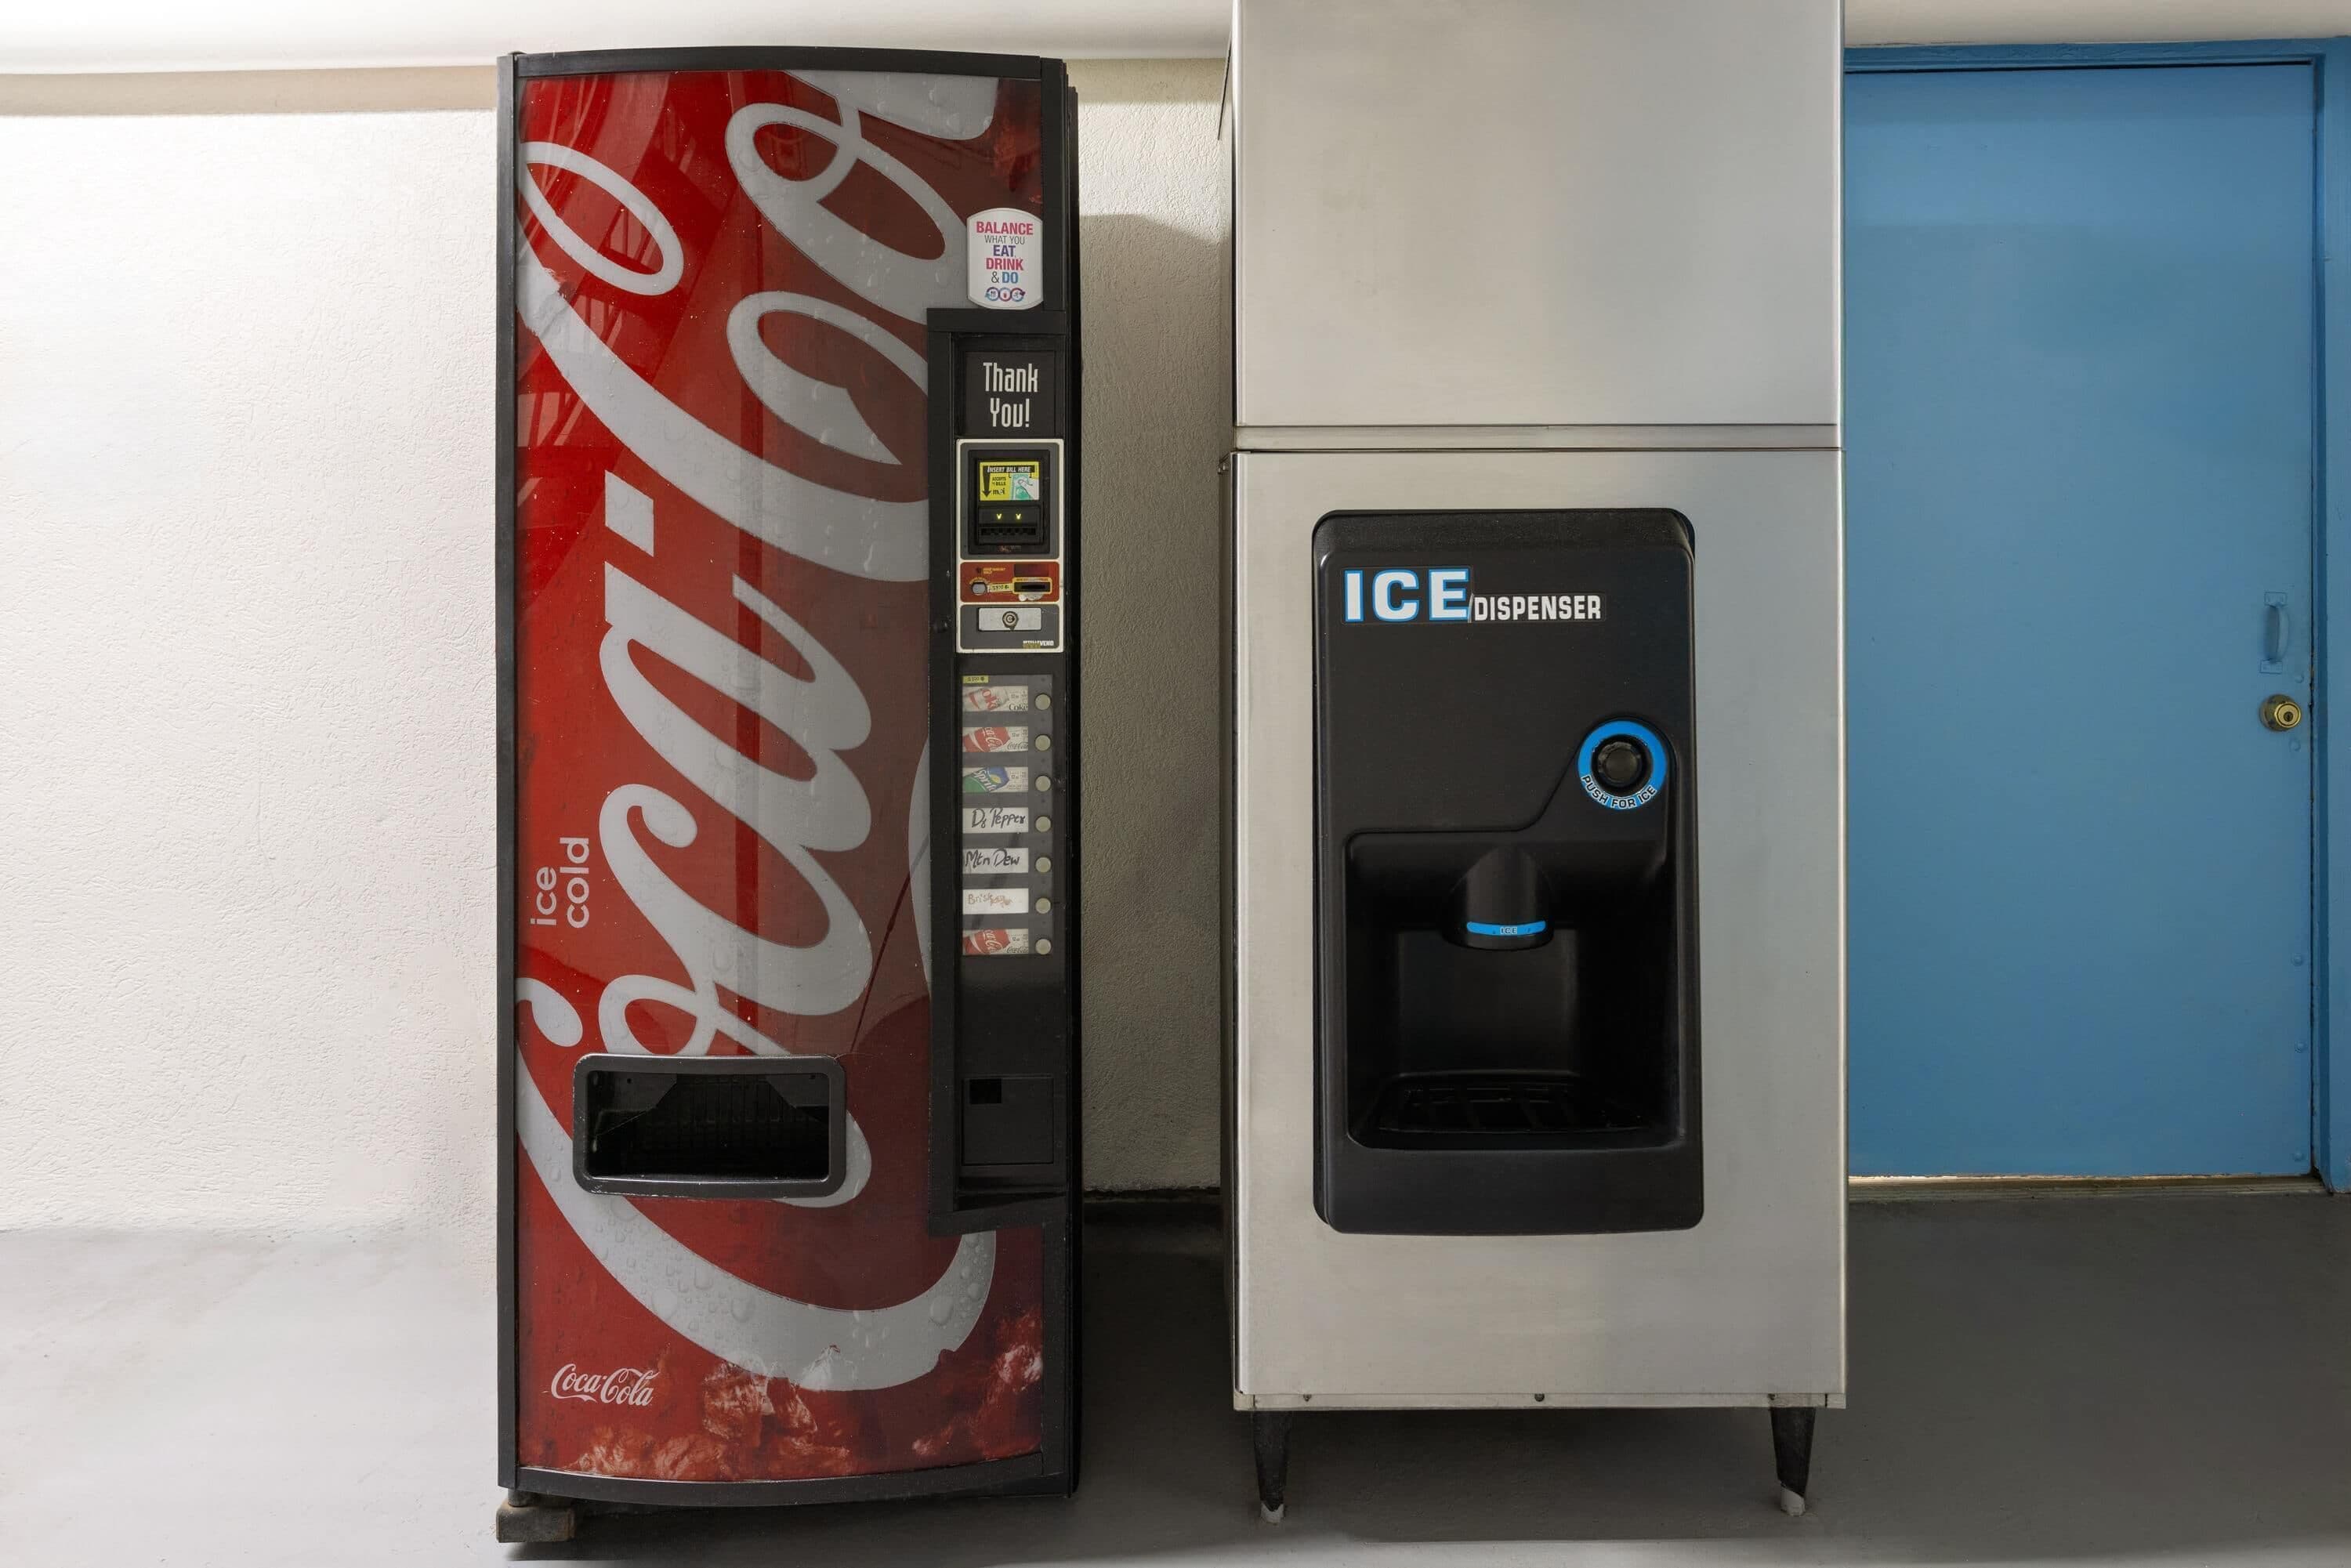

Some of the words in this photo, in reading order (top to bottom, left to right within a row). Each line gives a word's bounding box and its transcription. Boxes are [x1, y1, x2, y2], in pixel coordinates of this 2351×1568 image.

[976, 221, 1034, 235] BALANCE
[984, 235, 1007, 244] WHAT
[1009, 236, 1025, 244] YOU
[986, 258, 1023, 270] DRINK
[991, 271, 999, 283] &
[1002, 271, 1019, 284] DO
[983, 362, 1038, 393] Thank
[990, 397, 1030, 428] You!
[1344, 568, 1469, 622] ICE
[1474, 596, 1601, 621] DISPENSER
[517, 69, 999, 1393] Coca-Co
[1581, 774, 1609, 805] PUSH
[1611, 798, 1636, 809] FOR
[1638, 785, 1657, 804] ICE
[990, 807, 1025, 828] Pepper
[965, 850, 990, 867] Mtn
[993, 848, 1020, 866] Dew
[531, 867, 557, 925] ice
[560, 837, 589, 928] cold
[1500, 926, 1517, 935] ICE
[551, 1363, 661, 1406] Coca-Cola
